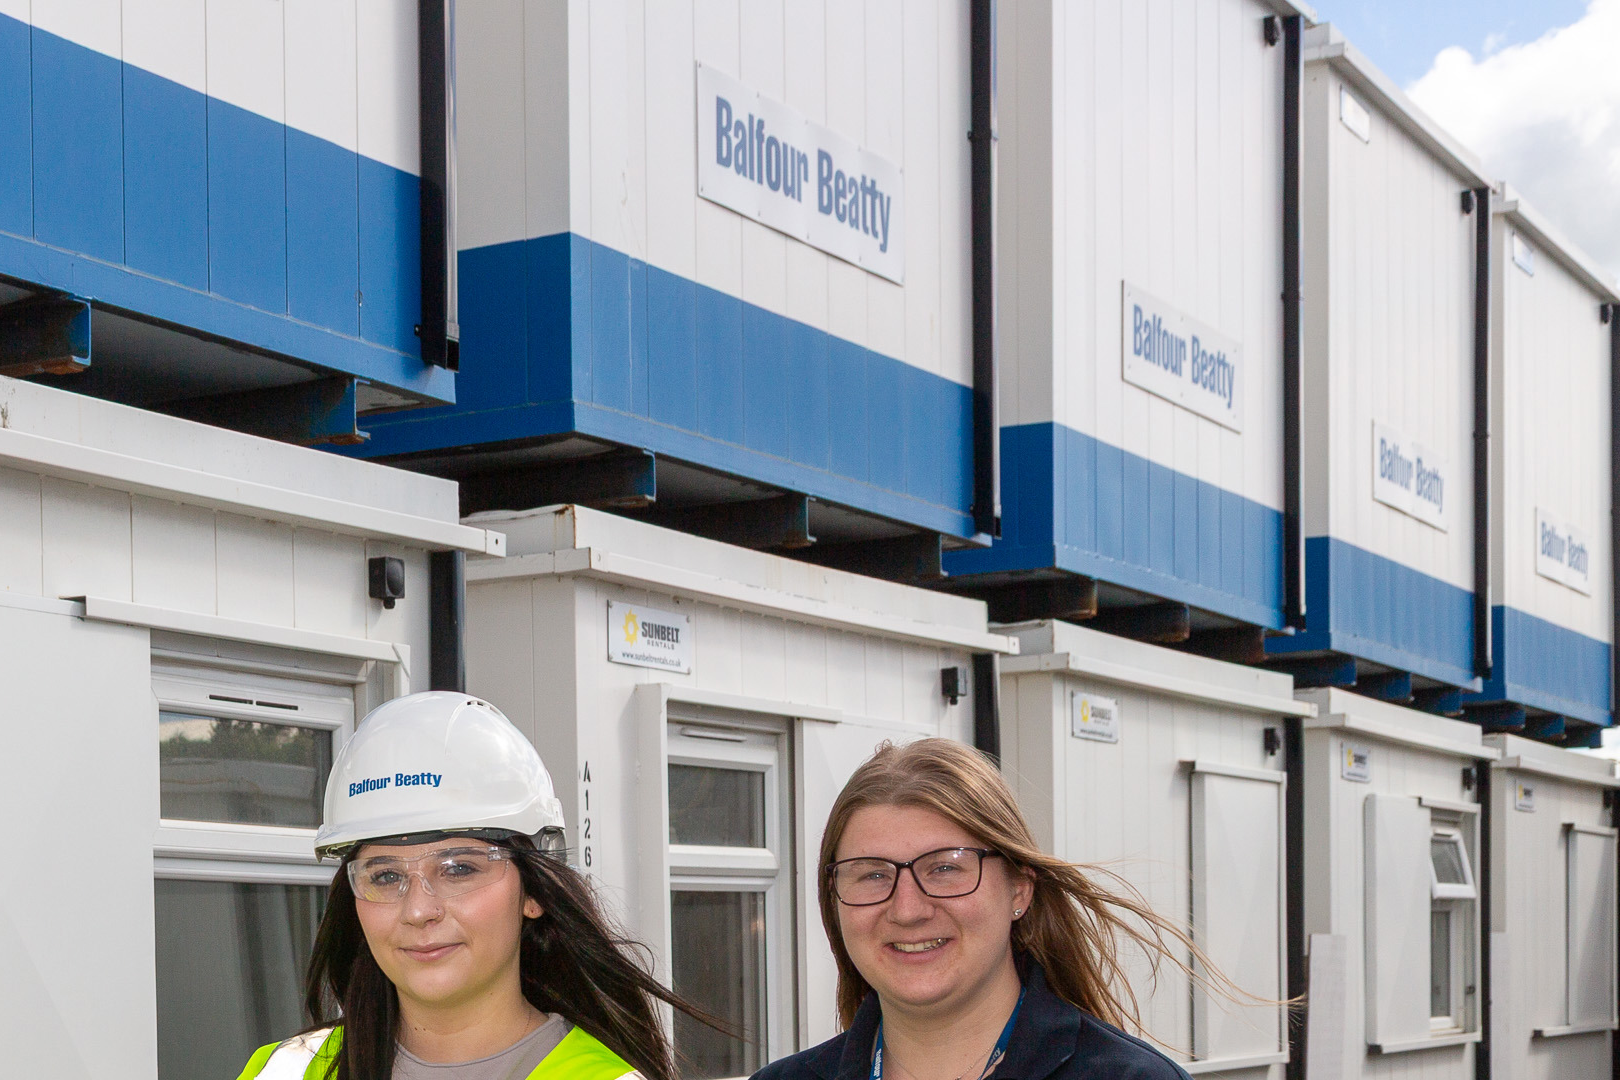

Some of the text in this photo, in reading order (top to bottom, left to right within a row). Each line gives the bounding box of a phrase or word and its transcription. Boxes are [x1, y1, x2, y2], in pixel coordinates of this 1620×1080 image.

[716, 95, 891, 253] Balfour Beatty
[1133, 304, 1235, 410] Balfour Beatty
[1380, 437, 1444, 514] Balfour Beatty
[641, 621, 680, 643] SUNBELT
[647, 640, 675, 650] RENTALS
[349, 772, 442, 797] Balfour Beatty
